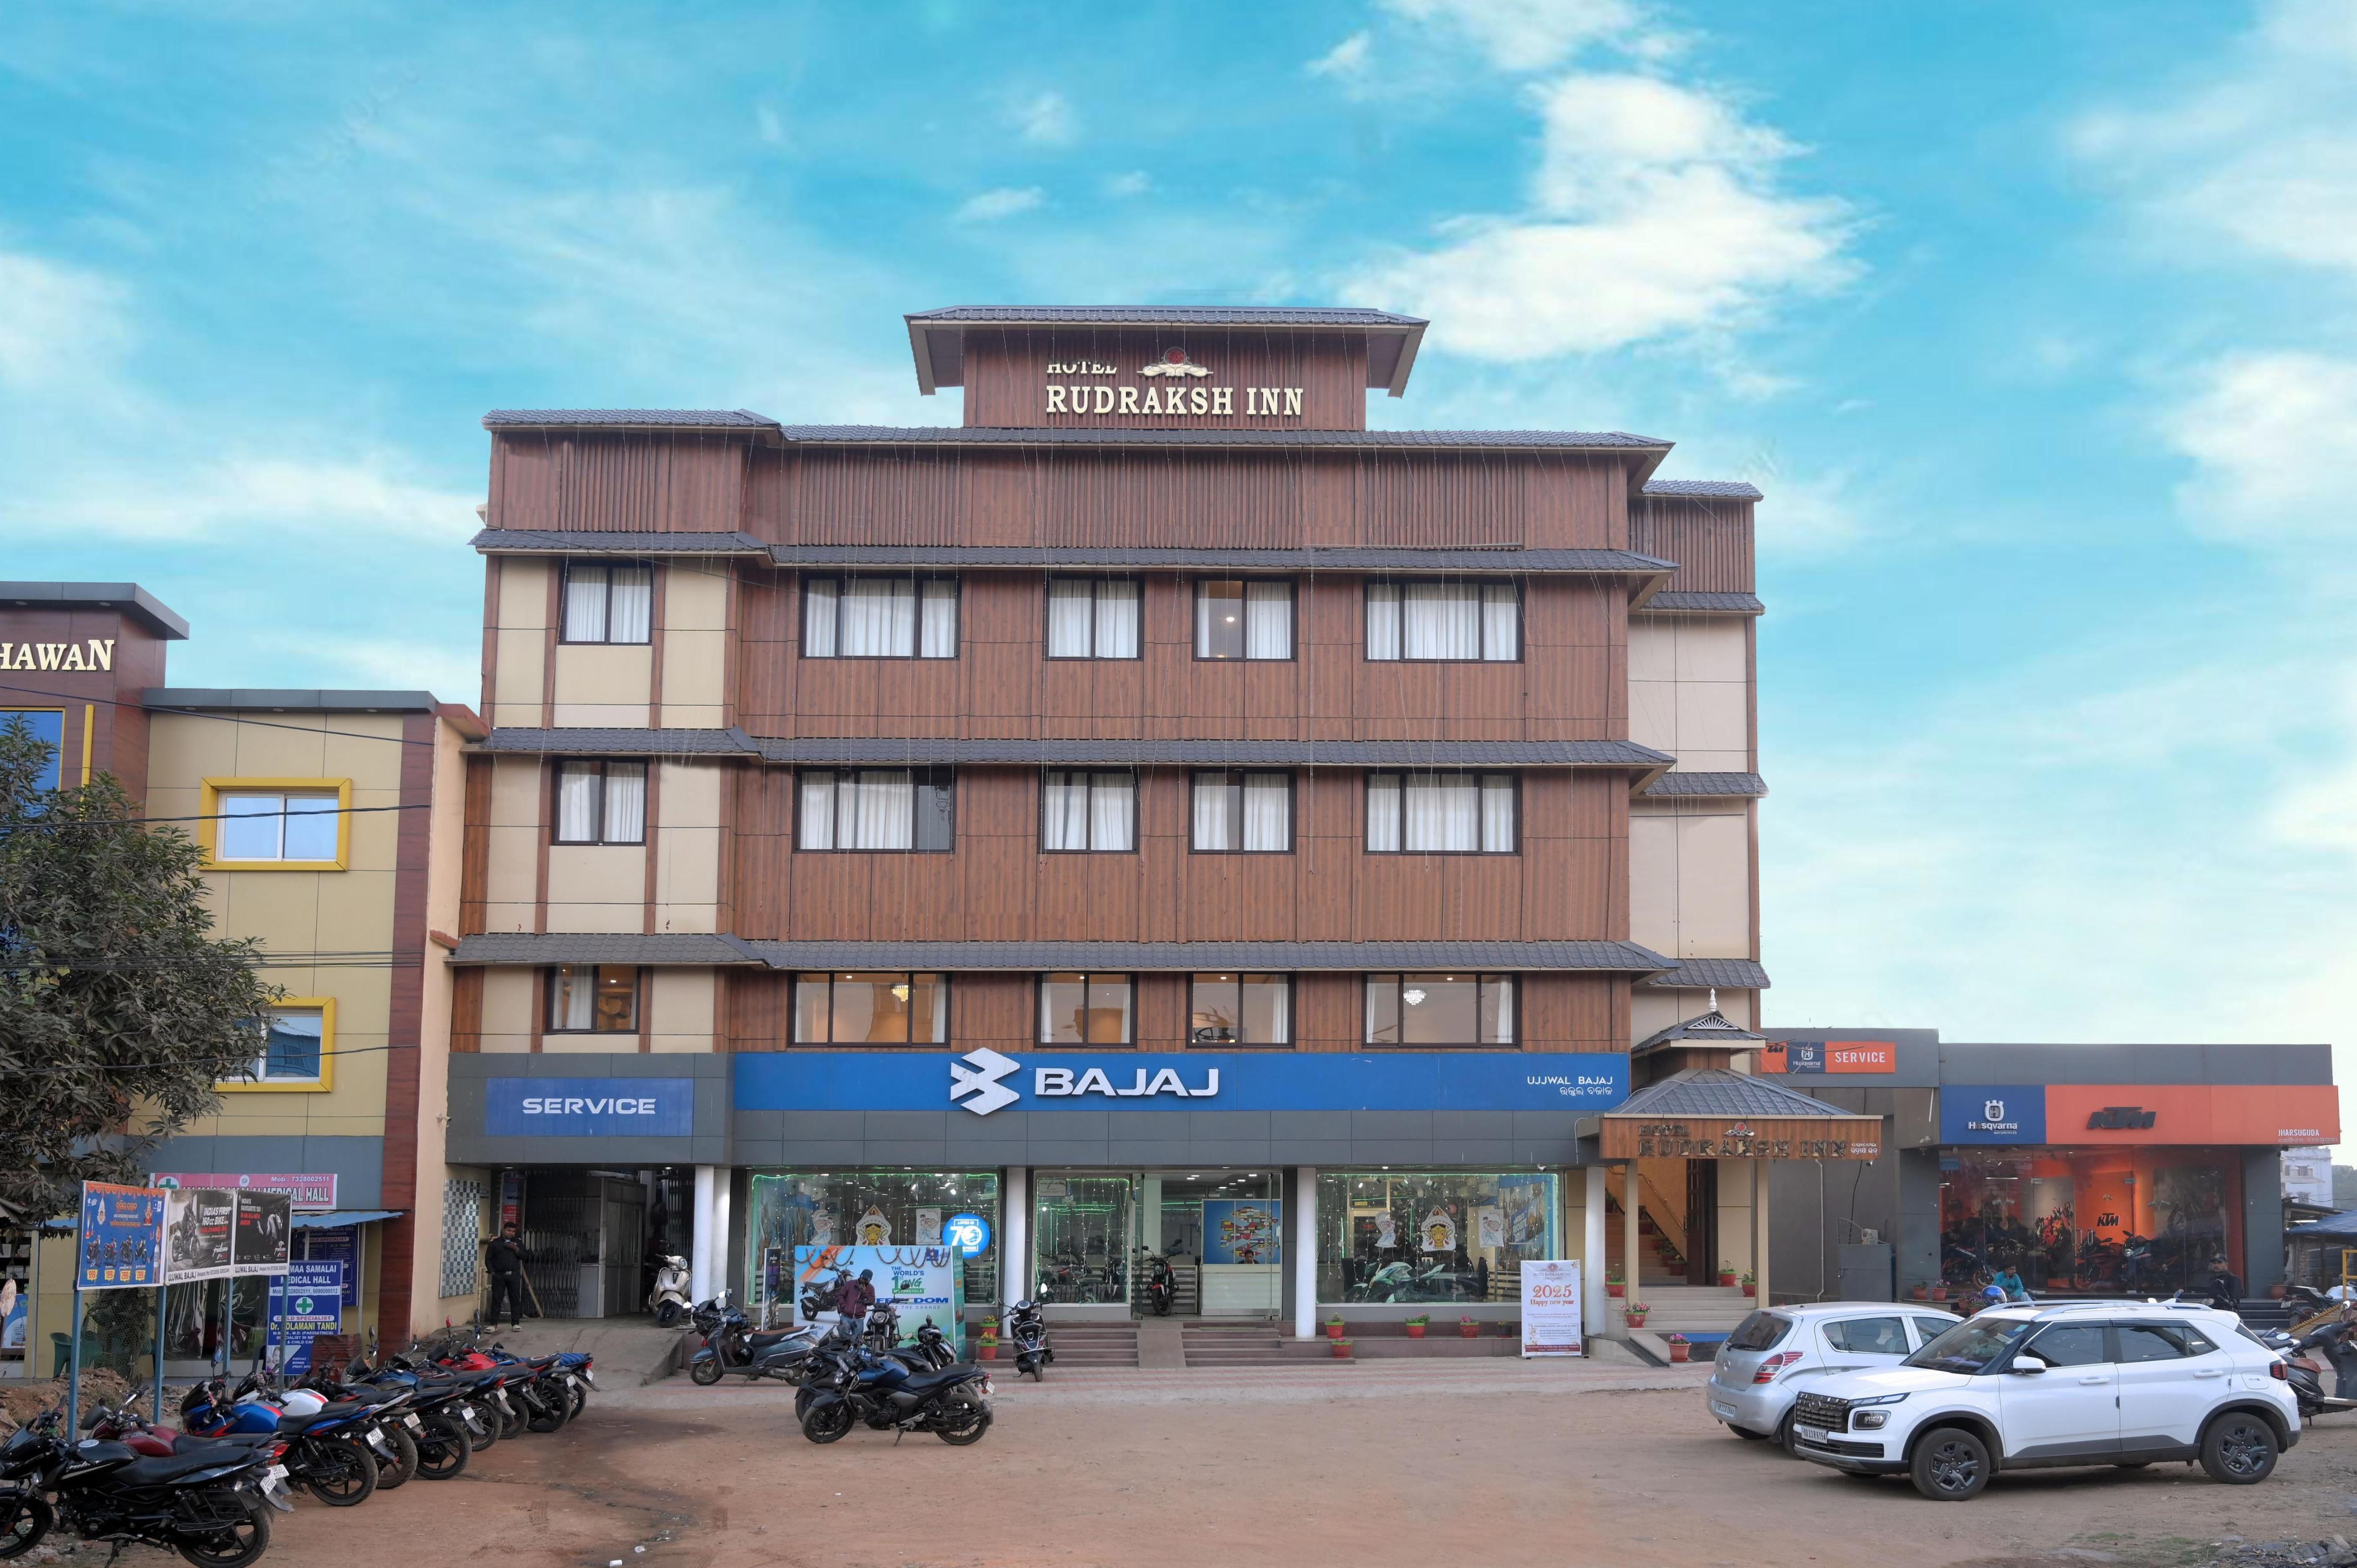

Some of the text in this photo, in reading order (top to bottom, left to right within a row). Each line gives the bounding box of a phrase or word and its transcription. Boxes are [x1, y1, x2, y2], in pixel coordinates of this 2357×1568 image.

[1047, 361, 1117, 374] HOTEL
[1047, 385, 1303, 415] RUDRAKSH INN
[1835, 1052, 1885, 1063] SERVICE
[1035, 1068, 1219, 1097] BAJAJ
[1527, 1076, 1613, 1085] UJJWAL BAJAJ
[522, 1098, 657, 1114] SERVICE
[2087, 1106, 2157, 1130] KTM
[1968, 1121, 2018, 1131] Husqvarna
[1638, 1139, 1847, 1157] RUDRAKSH INN
[306, 1186, 329, 1202] HALL
[218, 1206, 232, 1216] FIRST
[2096, 1212, 2119, 1227] KTM
[168, 1271, 184, 1282] UJJWAL
[184, 1271, 196, 1280] BAJAJ
[1533, 1284, 1572, 1298] 2025
[317, 1322, 337, 1330] TANDI
